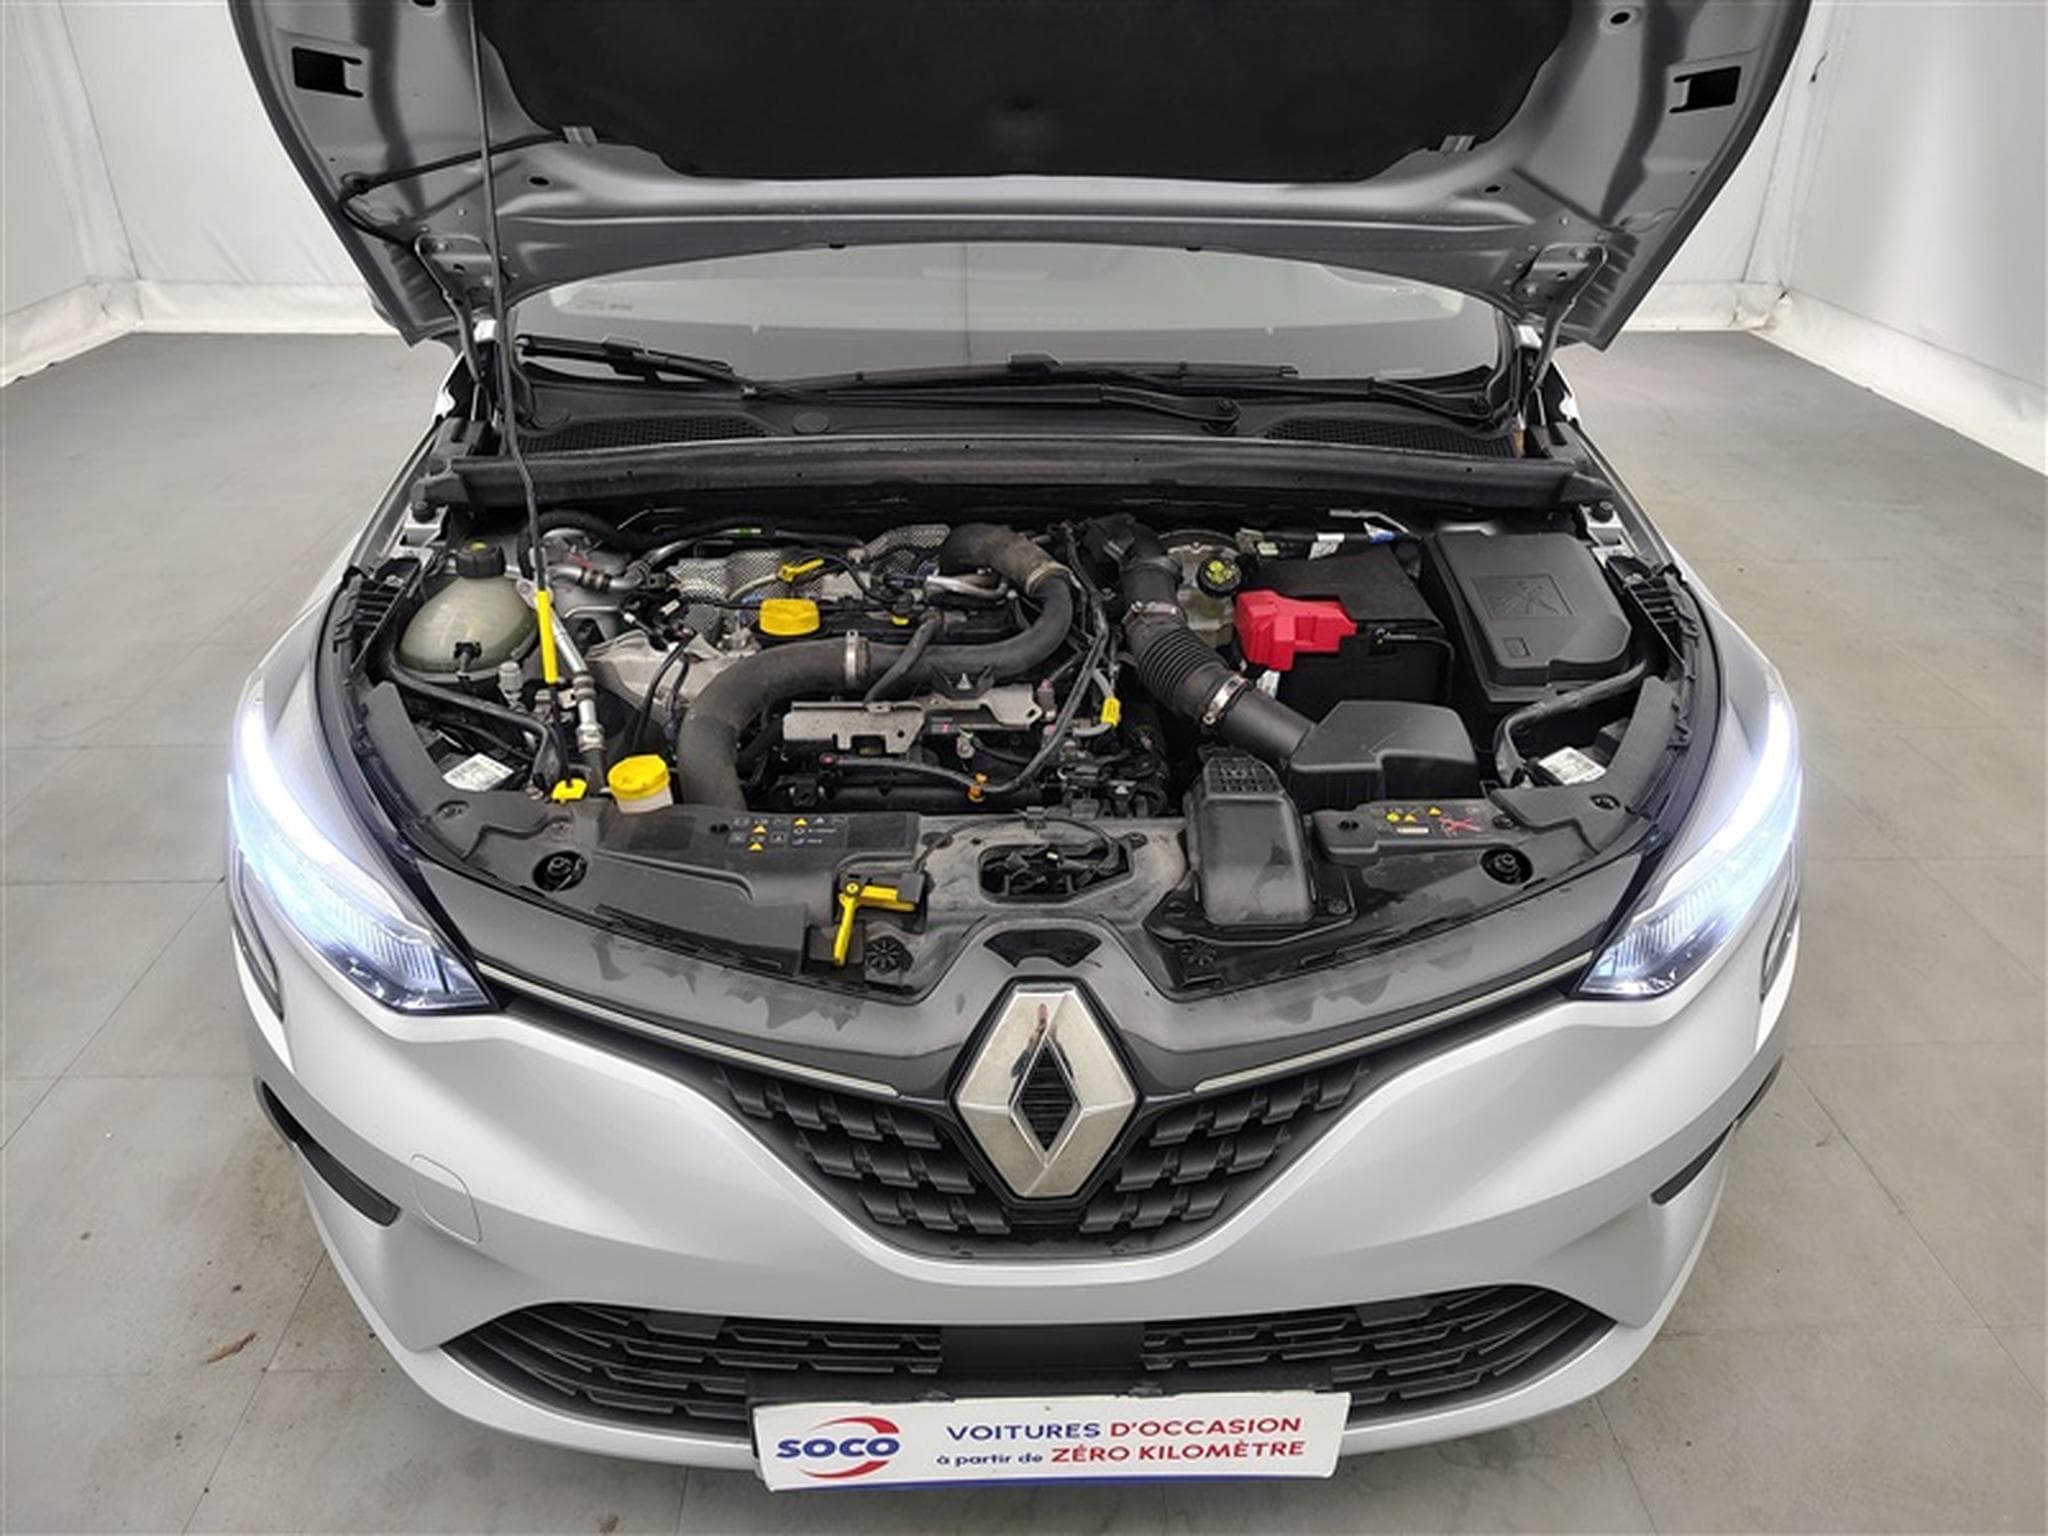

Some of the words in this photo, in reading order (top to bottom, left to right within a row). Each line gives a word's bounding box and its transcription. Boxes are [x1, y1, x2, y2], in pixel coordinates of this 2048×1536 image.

[946, 1422, 1101, 1441] VOITURES
[1110, 1417, 1302, 1437] D'OCCASION
[776, 1437, 901, 1459] SOCO
[936, 1453, 951, 1466] à
[955, 1454, 1012, 1468] partir
[1017, 1453, 1044, 1464] de
[1051, 1444, 1131, 1463] ZÉRO
[1138, 1440, 1306, 1461] KILOMÈTRE
